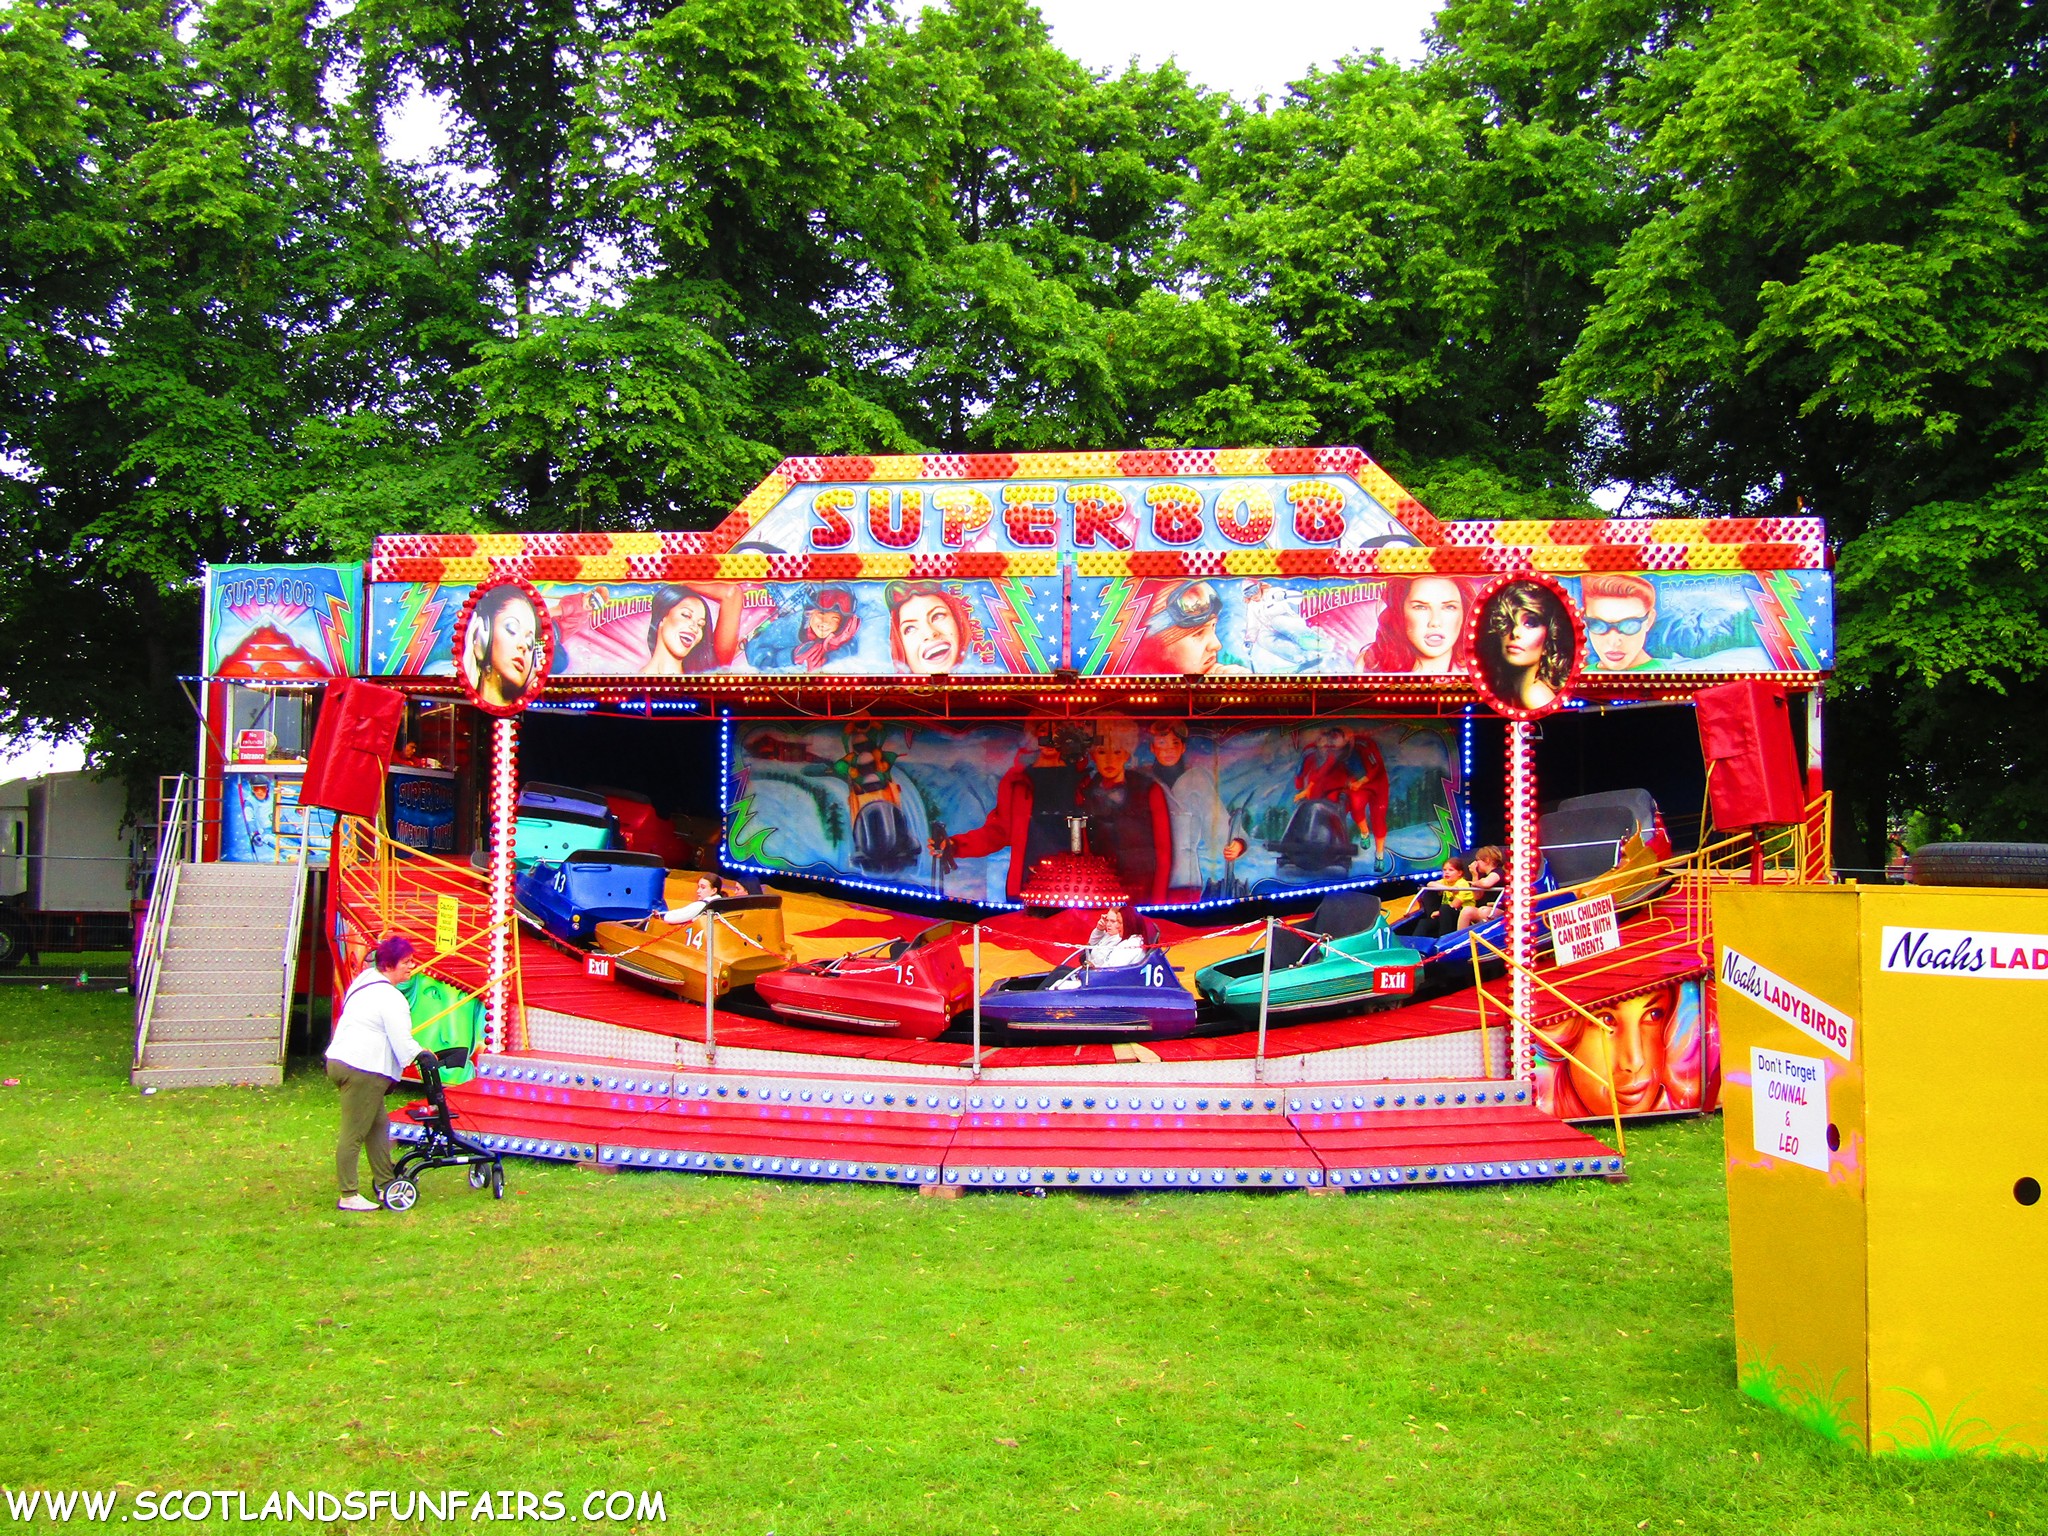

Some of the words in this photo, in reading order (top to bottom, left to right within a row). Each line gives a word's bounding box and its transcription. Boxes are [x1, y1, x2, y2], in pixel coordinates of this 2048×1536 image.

[223, 577, 279, 608] SUPER
[281, 577, 316, 608] BOB
[1298, 581, 1387, 619] ADRENALIN
[589, 594, 654, 631] ULTIMATE
[240, 752, 265, 760] Entrance
[553, 871, 566, 893] 13
[1551, 909, 1577, 930] SMALL
[1577, 898, 1612, 922] CHILDREN
[684, 927, 705, 950] 14
[1557, 928, 1574, 946] CAN
[1574, 922, 1592, 941] RIDE
[1592, 916, 1612, 935] WITH
[1571, 936, 1605, 960] PARENTS
[1888, 931, 1987, 972] Noahs
[1990, 946, 2048, 970] LAD
[587, 958, 609, 976] Exit
[894, 964, 915, 986] 15
[1140, 964, 1164, 988] 16
[1380, 972, 1406, 989] Exit
[1722, 951, 1762, 997] Noahs
[1763, 979, 1848, 1048] LADYBIRDS
[1758, 1054, 1782, 1074] Don't
[1785, 1060, 1816, 1083] Forget
[1768, 1080, 1808, 1106] CONNAL
[1779, 1132, 1799, 1156] LEO
